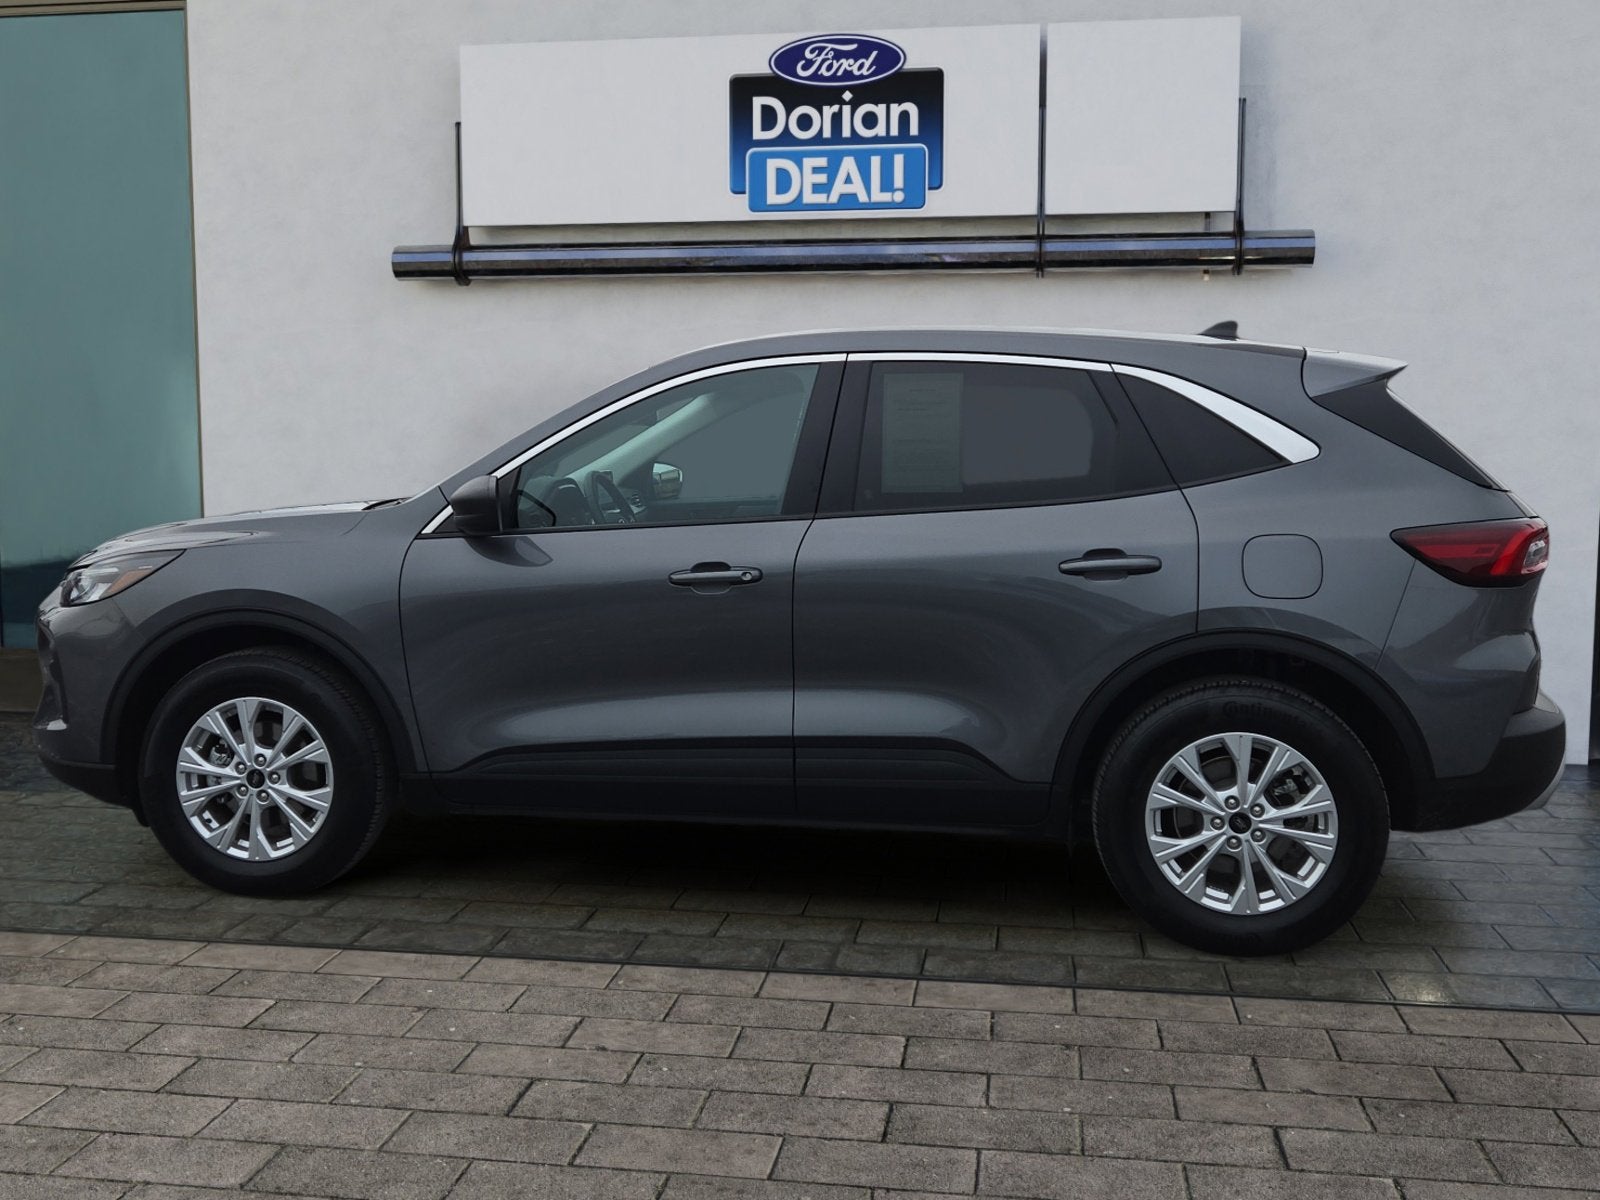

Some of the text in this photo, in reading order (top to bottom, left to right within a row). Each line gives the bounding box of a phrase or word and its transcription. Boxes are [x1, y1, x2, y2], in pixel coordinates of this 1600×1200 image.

[796, 43, 878, 77] Ford
[752, 90, 919, 140] Dorian
[766, 153, 905, 205] DEAL!
